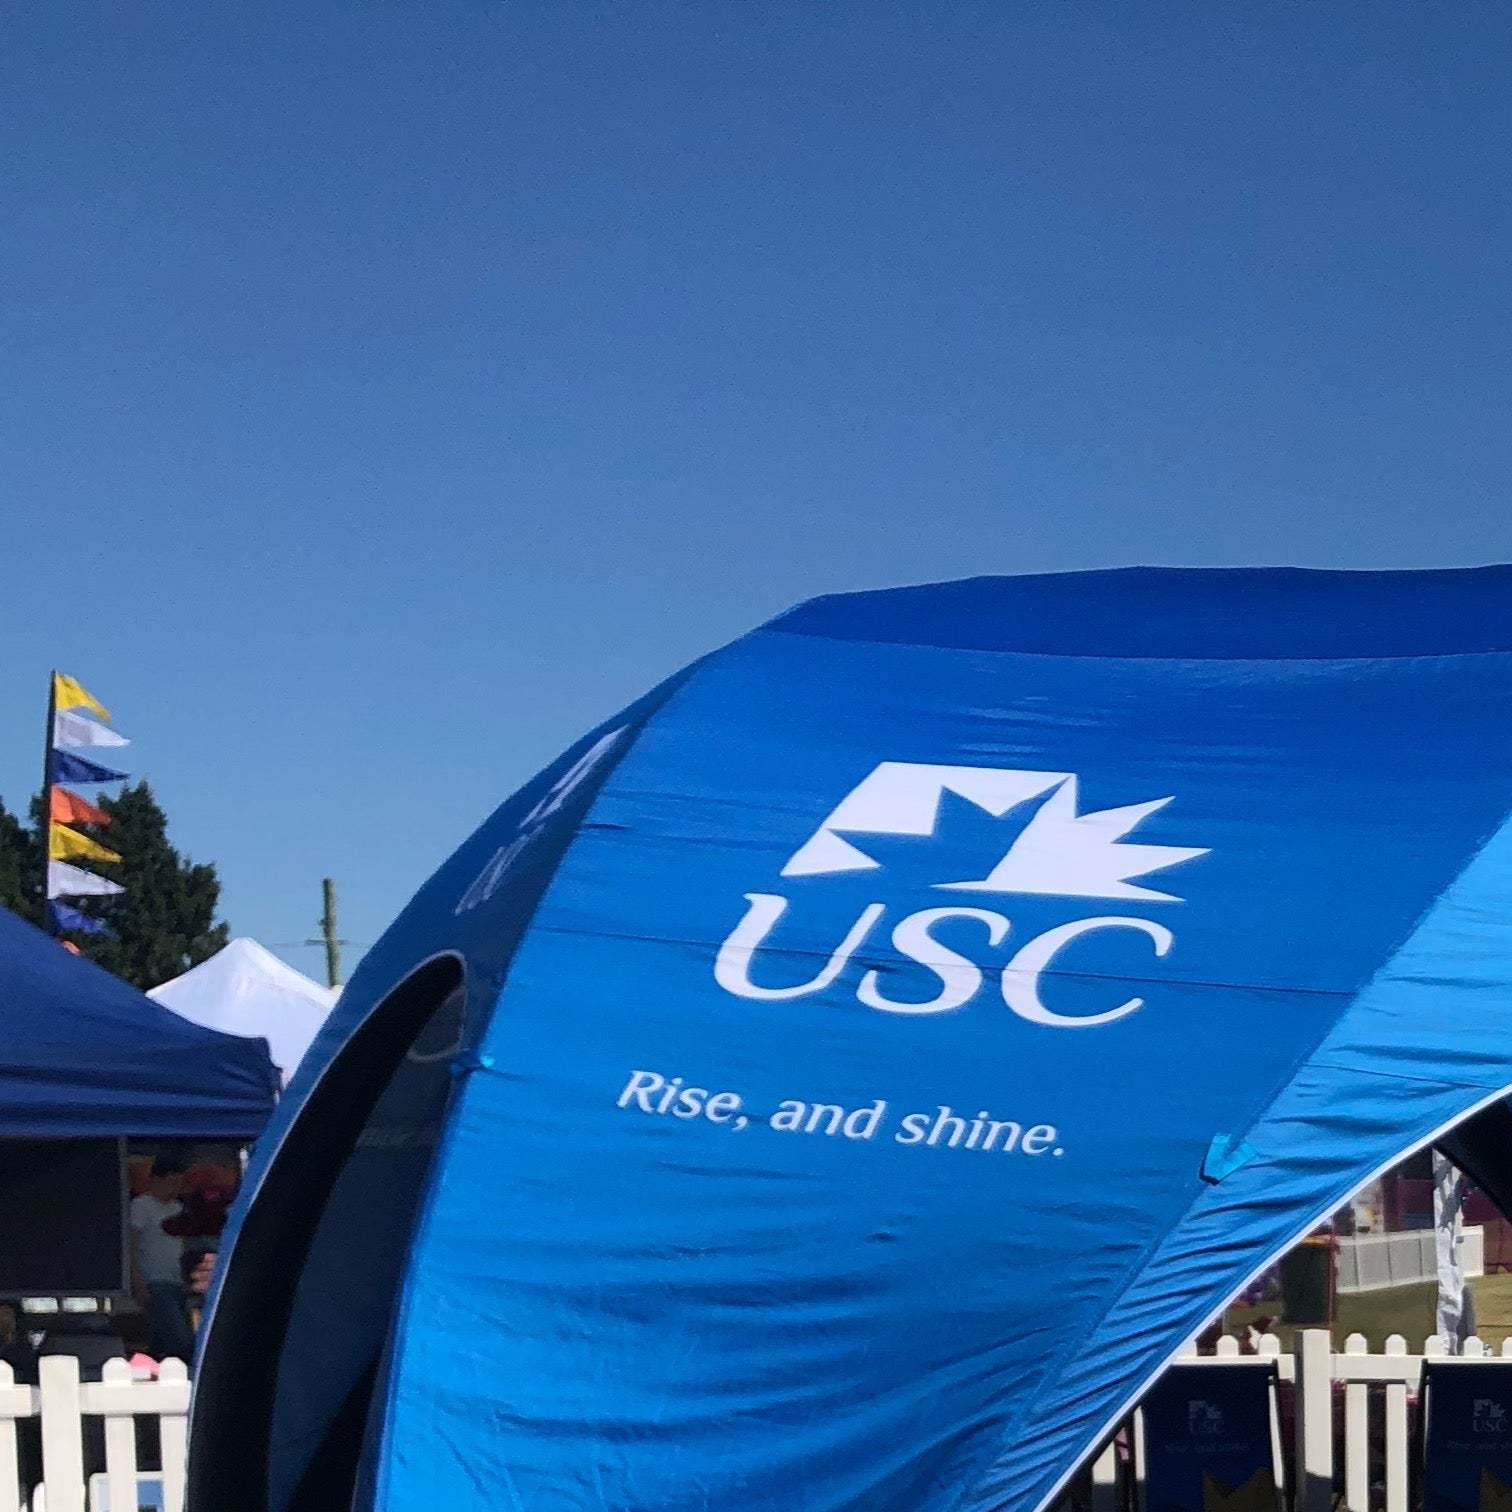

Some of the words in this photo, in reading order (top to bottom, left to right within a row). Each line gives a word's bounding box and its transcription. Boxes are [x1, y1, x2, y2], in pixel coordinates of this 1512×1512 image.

[714, 892, 1175, 1027] USC
[616, 1069, 748, 1131] Rise,
[769, 1099, 889, 1141] and
[894, 1106, 1066, 1158] shine.
